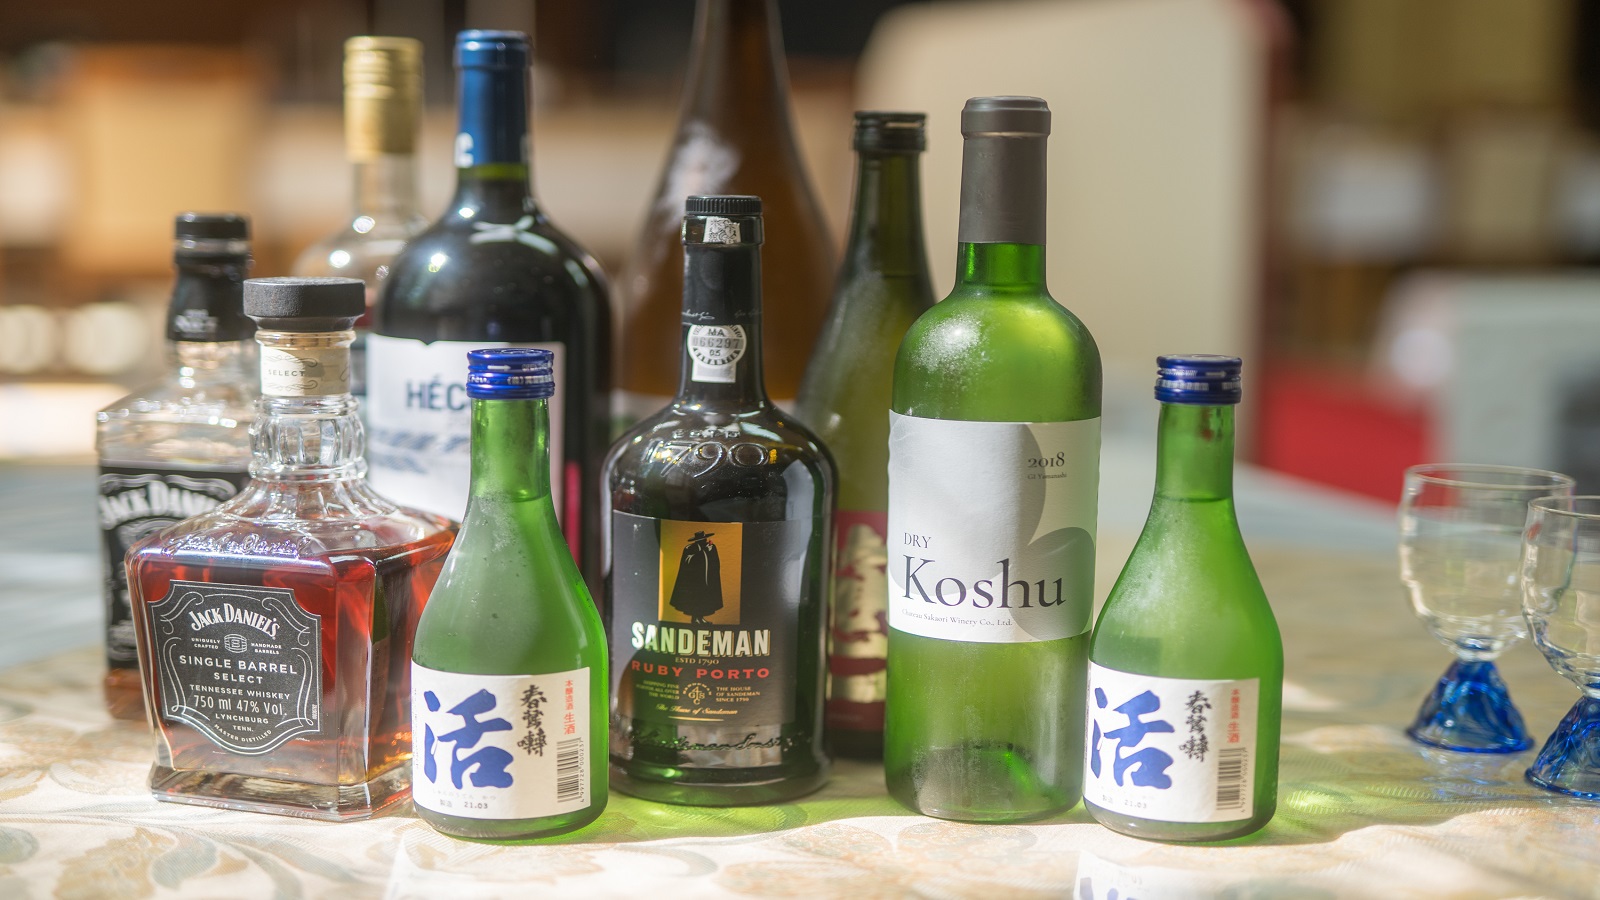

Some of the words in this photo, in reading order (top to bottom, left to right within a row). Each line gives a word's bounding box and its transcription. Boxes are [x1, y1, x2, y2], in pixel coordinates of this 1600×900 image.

[268, 369, 306, 377] SELECT
[1027, 451, 1065, 468] 2018
[903, 532, 932, 549] DRY
[902, 554, 1067, 609] Koshu
[188, 608, 224, 631] JACK
[223, 603, 280, 638] DANIEL'S
[923, 613, 948, 623] Sakaori
[949, 616, 978, 627] Winery
[997, 618, 1013, 626] Ltd.
[250, 642, 282, 650] HANDMADE
[631, 621, 771, 657] SANDEMAN
[179, 654, 232, 669] SINGLE
[238, 659, 298, 675] BARREL
[631, 660, 684, 677] RUBY
[696, 667, 770, 680] PORTO
[675, 657, 696, 665] ESTD
[698, 658, 720, 666] 1790
[213, 671, 264, 685] SELECT
[189, 684, 244, 696] TENNESSEE
[247, 689, 290, 700] WHISKEY
[193, 694, 214, 709] 750
[218, 697, 232, 710] ml
[236, 699, 260, 713] 47%
[264, 702, 288, 716] Vol.
[692, 707, 702, 715] of
[702, 707, 739, 715] Sandeman
[215, 713, 269, 724] LYNCHBURG
[563, 712, 576, 735] 生酒
[214, 723, 239, 741] MASTER
[241, 729, 272, 743] DISTILLED
[232, 724, 254, 732] TENN.
[423, 688, 514, 790] 活
[1091, 687, 1175, 789] 活
[464, 801, 489, 809] 21.03
